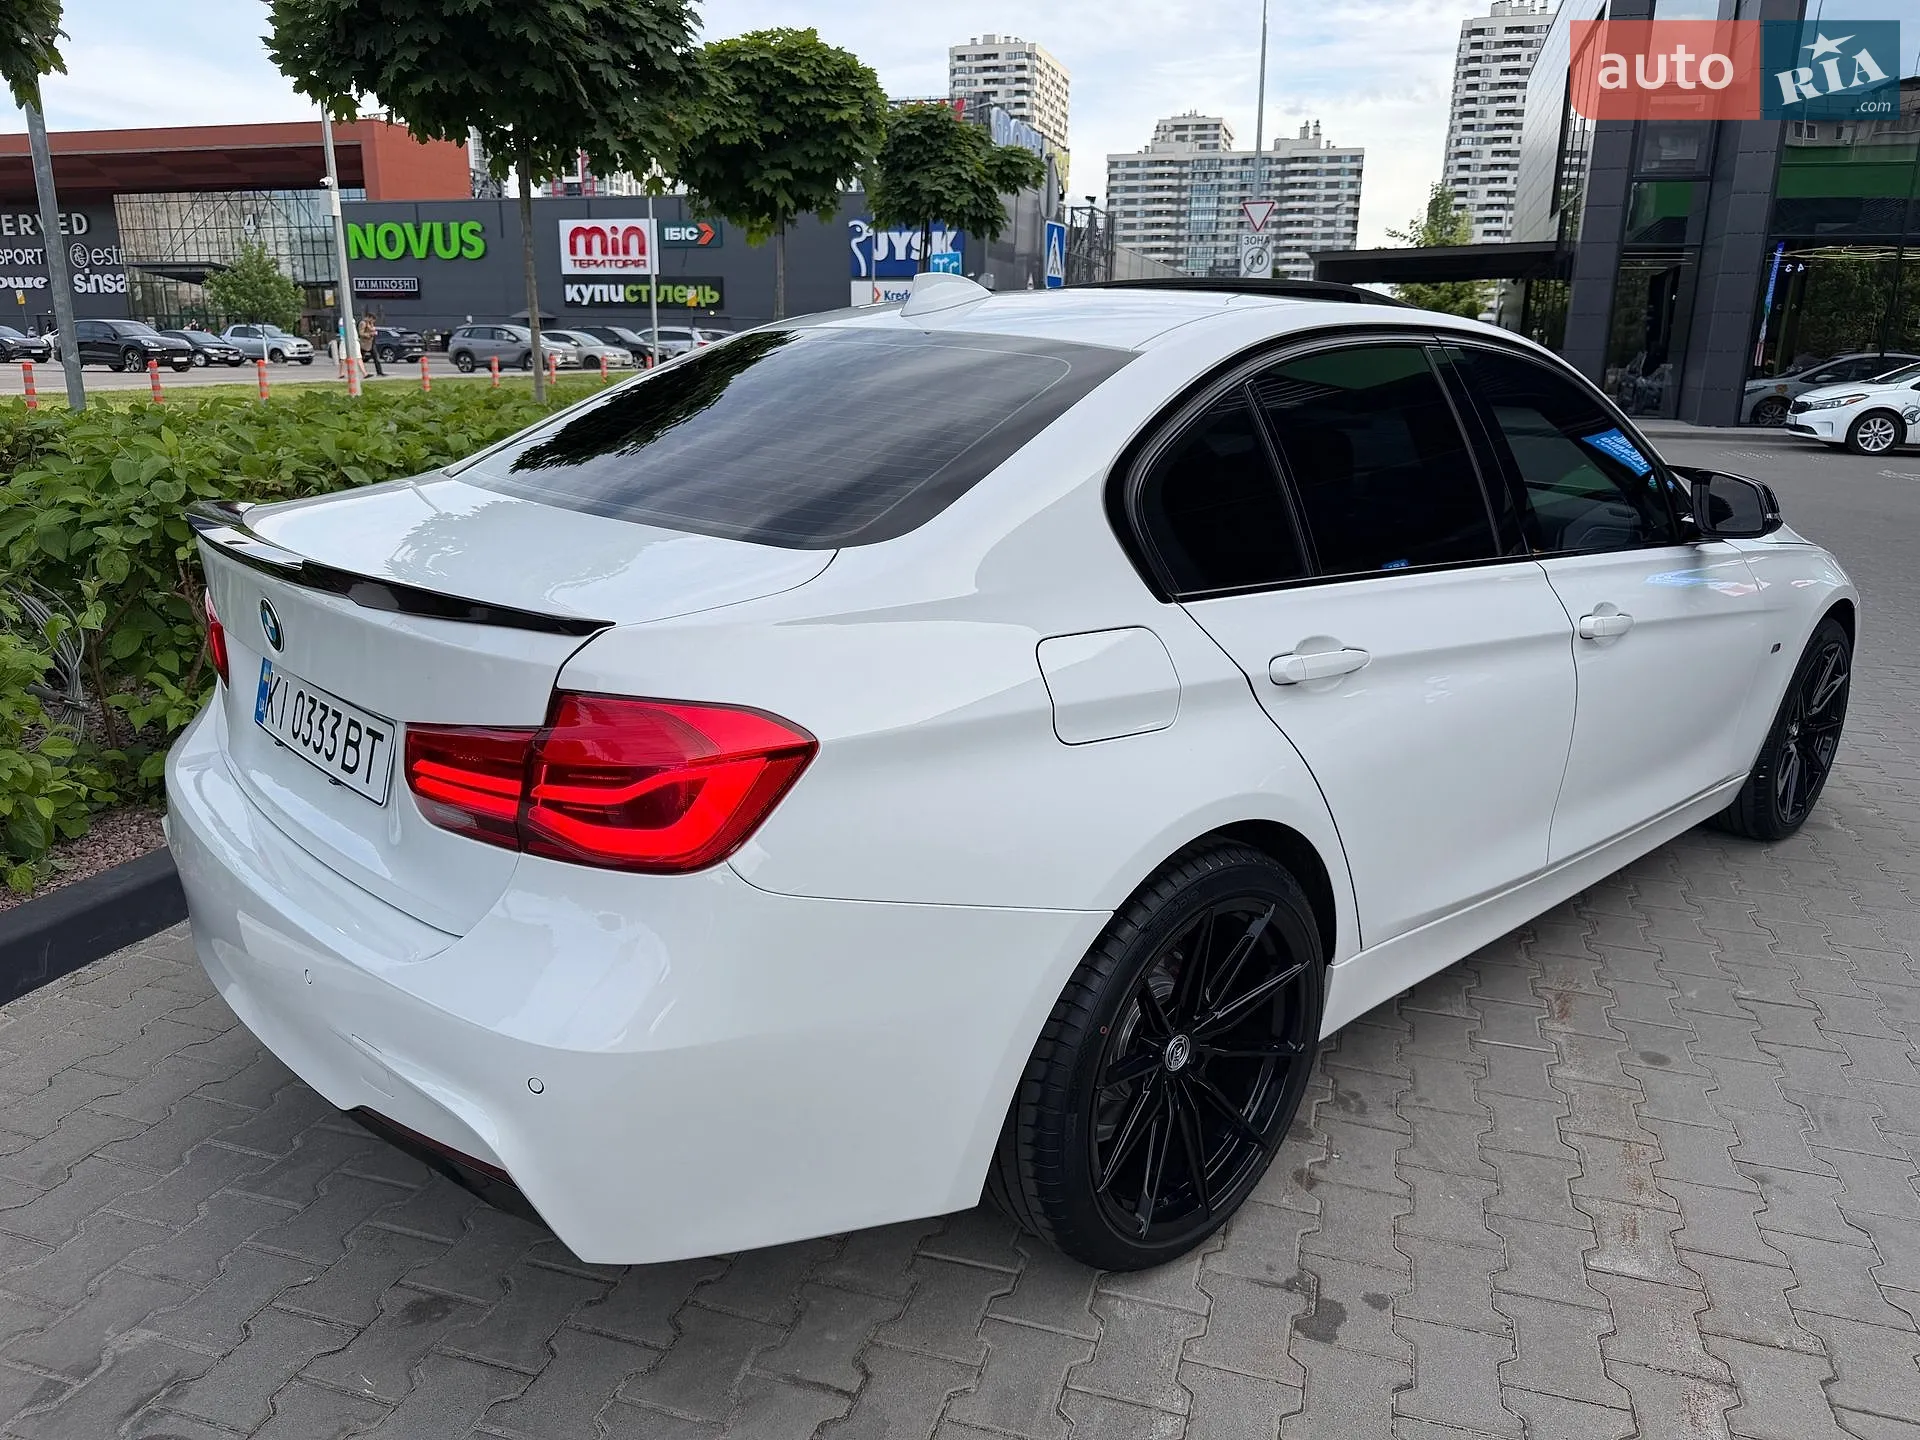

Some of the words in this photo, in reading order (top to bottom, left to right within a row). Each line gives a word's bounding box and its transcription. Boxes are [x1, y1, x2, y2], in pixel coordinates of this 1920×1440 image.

[347, 221, 486, 260] NOVUS
[664, 227, 699, 241] ІБІС
[873, 231, 957, 261] JYSK
[571, 258, 648, 269] ТЕРИТОРІЯ
[357, 280, 414, 290] MIMINOSHI
[565, 284, 720, 307] купистлець
